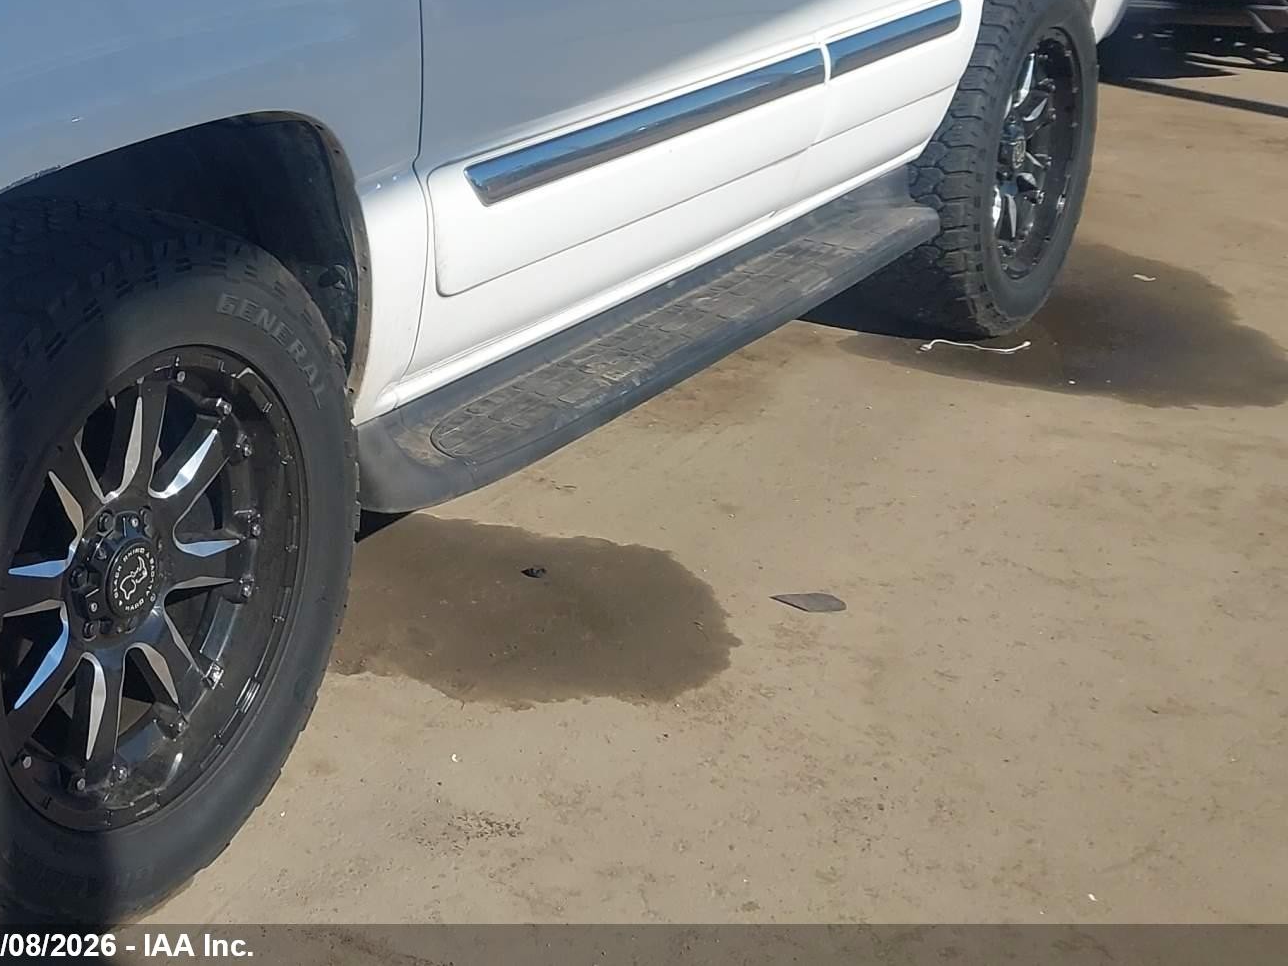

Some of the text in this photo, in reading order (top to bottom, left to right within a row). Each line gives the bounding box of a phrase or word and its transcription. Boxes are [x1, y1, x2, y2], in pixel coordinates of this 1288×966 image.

[216, 294, 325, 411] GENERAL
[114, 548, 145, 599] BLACK RHINO
